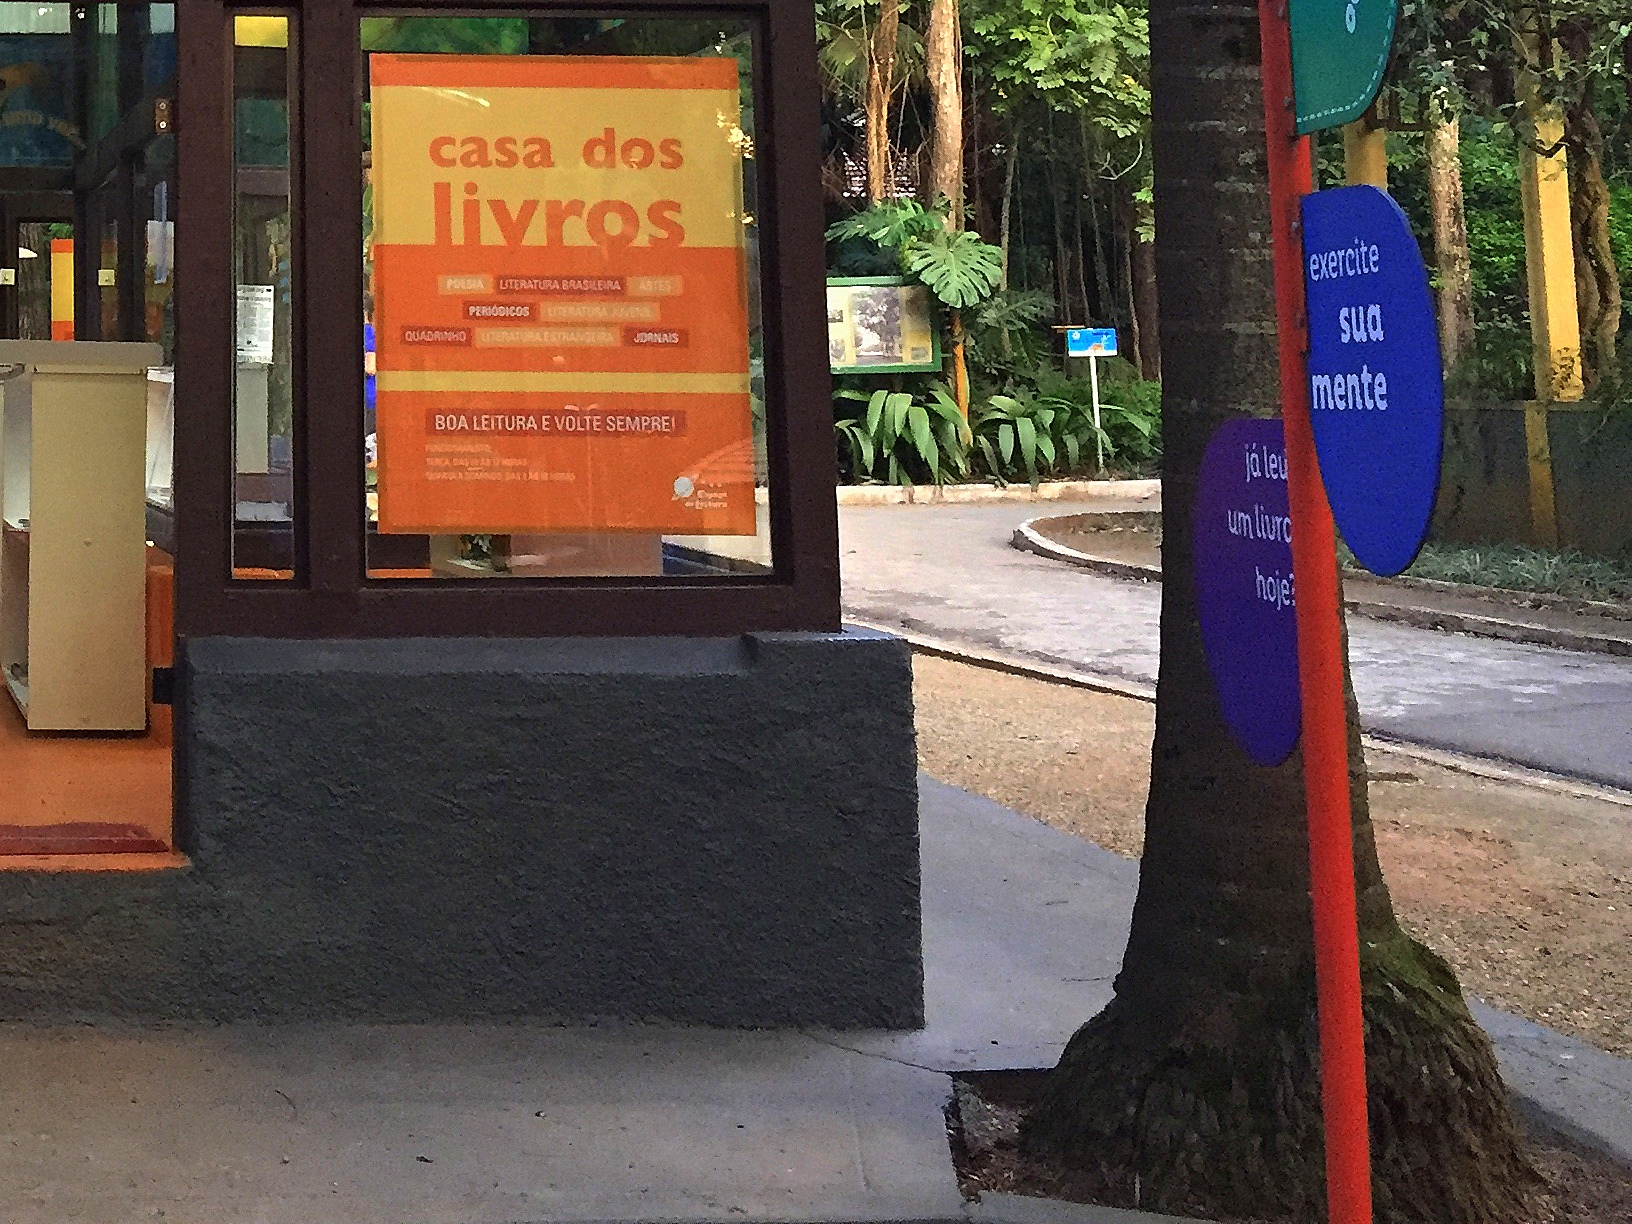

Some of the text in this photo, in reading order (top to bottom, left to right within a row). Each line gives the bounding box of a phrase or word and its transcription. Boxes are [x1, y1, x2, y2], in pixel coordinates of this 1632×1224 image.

[429, 127, 685, 170] casa dos
[433, 181, 687, 249] livros
[1308, 236, 1380, 283] exercite
[499, 278, 622, 291] LITERATURA BRASILEIRA
[468, 304, 530, 317] PERIÓDICOS
[1339, 300, 1385, 344] sua
[404, 330, 467, 343] QUADRINHO
[633, 332, 680, 344] JORNAIS
[1311, 365, 1388, 412] mente
[434, 414, 676, 432] BOA LEITURA E VOLTE SEMPRE!
[1244, 443, 1288, 482] já leu
[1227, 508, 1254, 540] um
